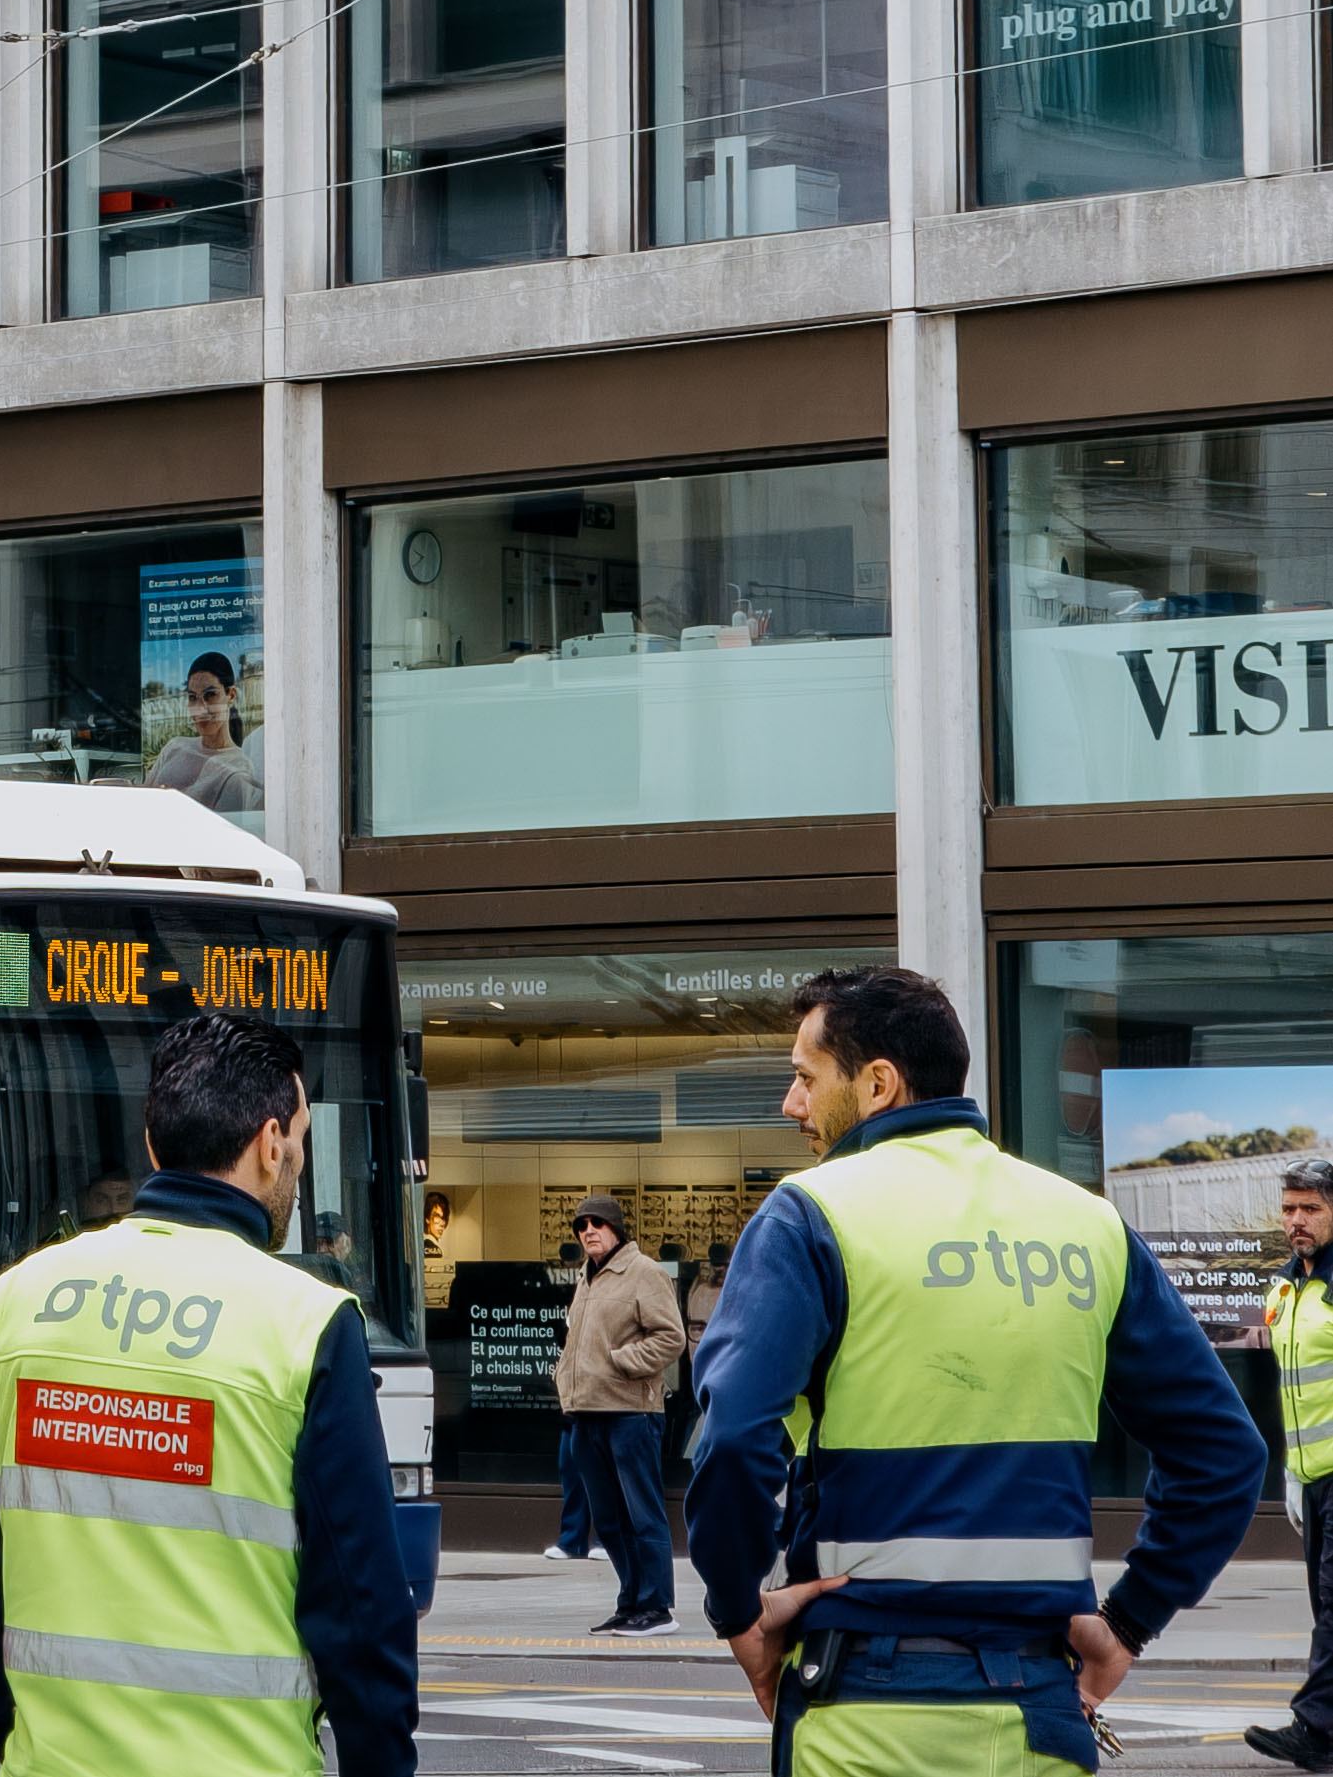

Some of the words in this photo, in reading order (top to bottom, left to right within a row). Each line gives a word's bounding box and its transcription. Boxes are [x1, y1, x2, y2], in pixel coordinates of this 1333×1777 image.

[1001, 3, 1077, 49] plug
[190, 599, 208, 609] CHF
[46, 939, 150, 1004] CIRQUE
[191, 944, 329, 1011] JONCTION
[665, 968, 753, 992] Lentilles
[759, 967, 785, 989] de
[480, 976, 505, 996] de
[511, 980, 547, 996] vue
[1180, 1239, 1197, 1252] de
[1198, 1241, 1223, 1252] vue
[1225, 1239, 1262, 1253] offert
[1197, 1272, 1228, 1287] CHF
[470, 1304, 488, 1319] Ce
[492, 1305, 512, 1322] qui
[515, 1308, 536, 1319] me
[1211, 1311, 1240, 1322] inclus
[470, 1323, 487, 1337] La
[490, 1324, 554, 1338] confiance
[471, 1341, 485, 1355] Et
[488, 1344, 518, 1358] pour
[522, 1344, 542, 1356] ma
[470, 1360, 483, 1377] je
[487, 1360, 533, 1375] choisis
[35, 1387, 191, 1425] RESPONSABLE
[32, 1417, 189, 1455] INTERVENTION
